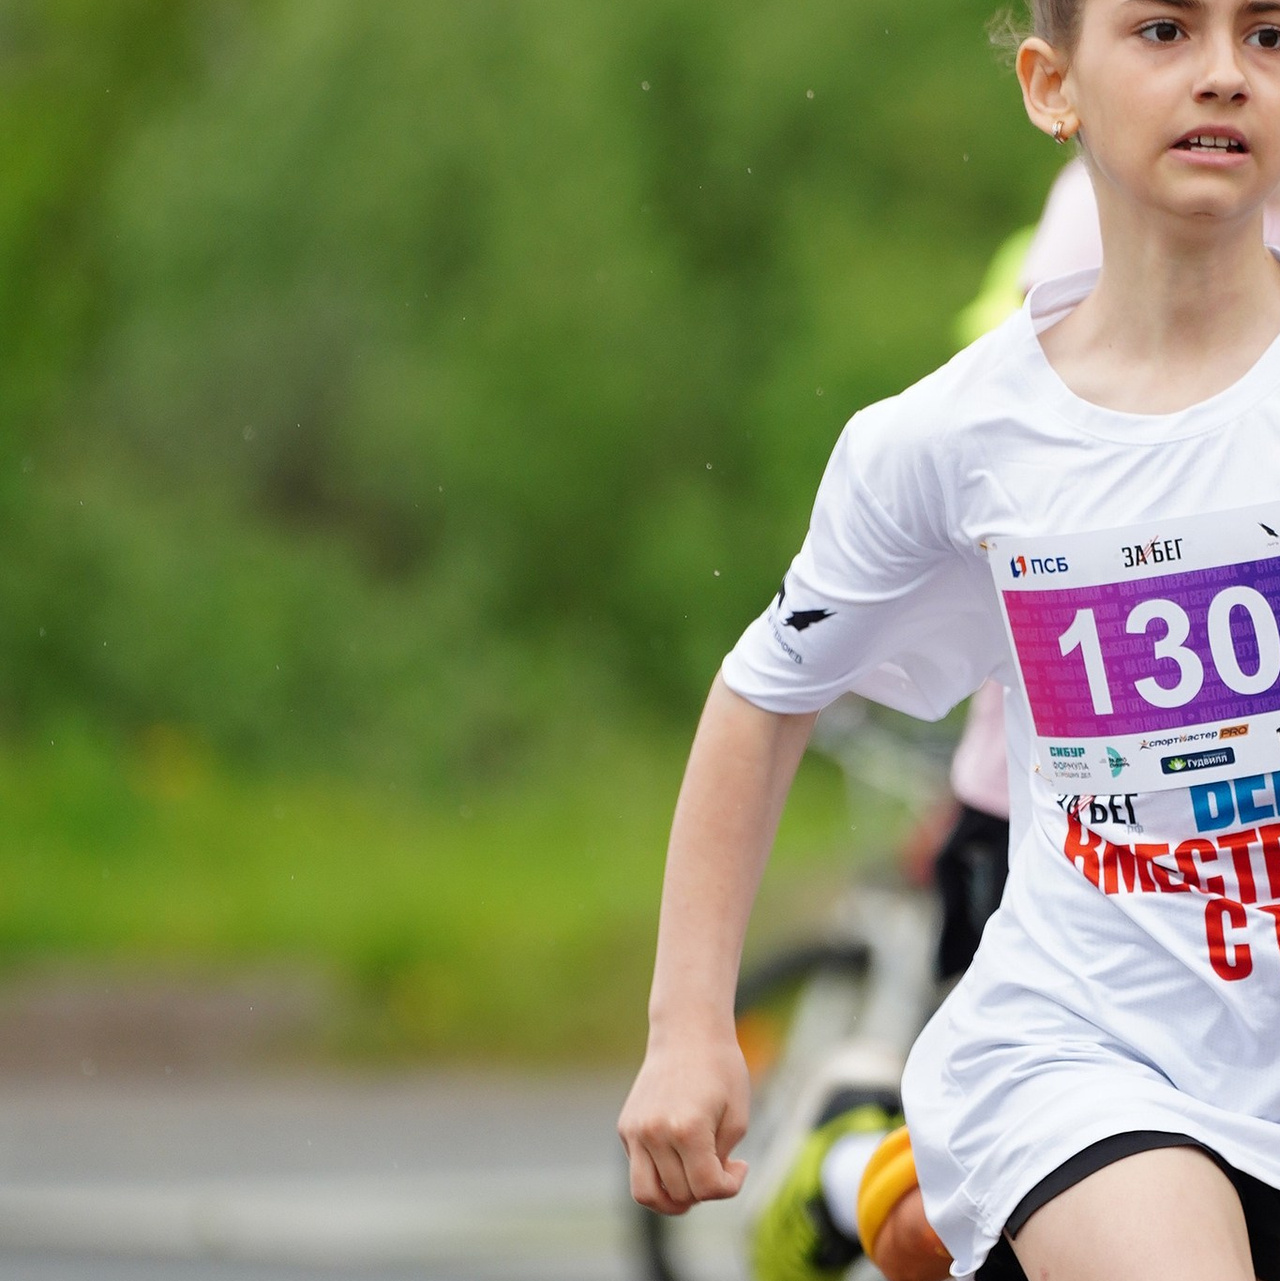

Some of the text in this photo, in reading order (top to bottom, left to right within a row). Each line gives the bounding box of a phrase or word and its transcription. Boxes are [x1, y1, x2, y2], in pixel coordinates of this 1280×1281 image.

[1031, 556, 1069, 575] ПСБ
[1220, 725, 1248, 738] PRO
[1049, 746, 1086, 758] СИБУР
[1204, 897, 1254, 982] С
